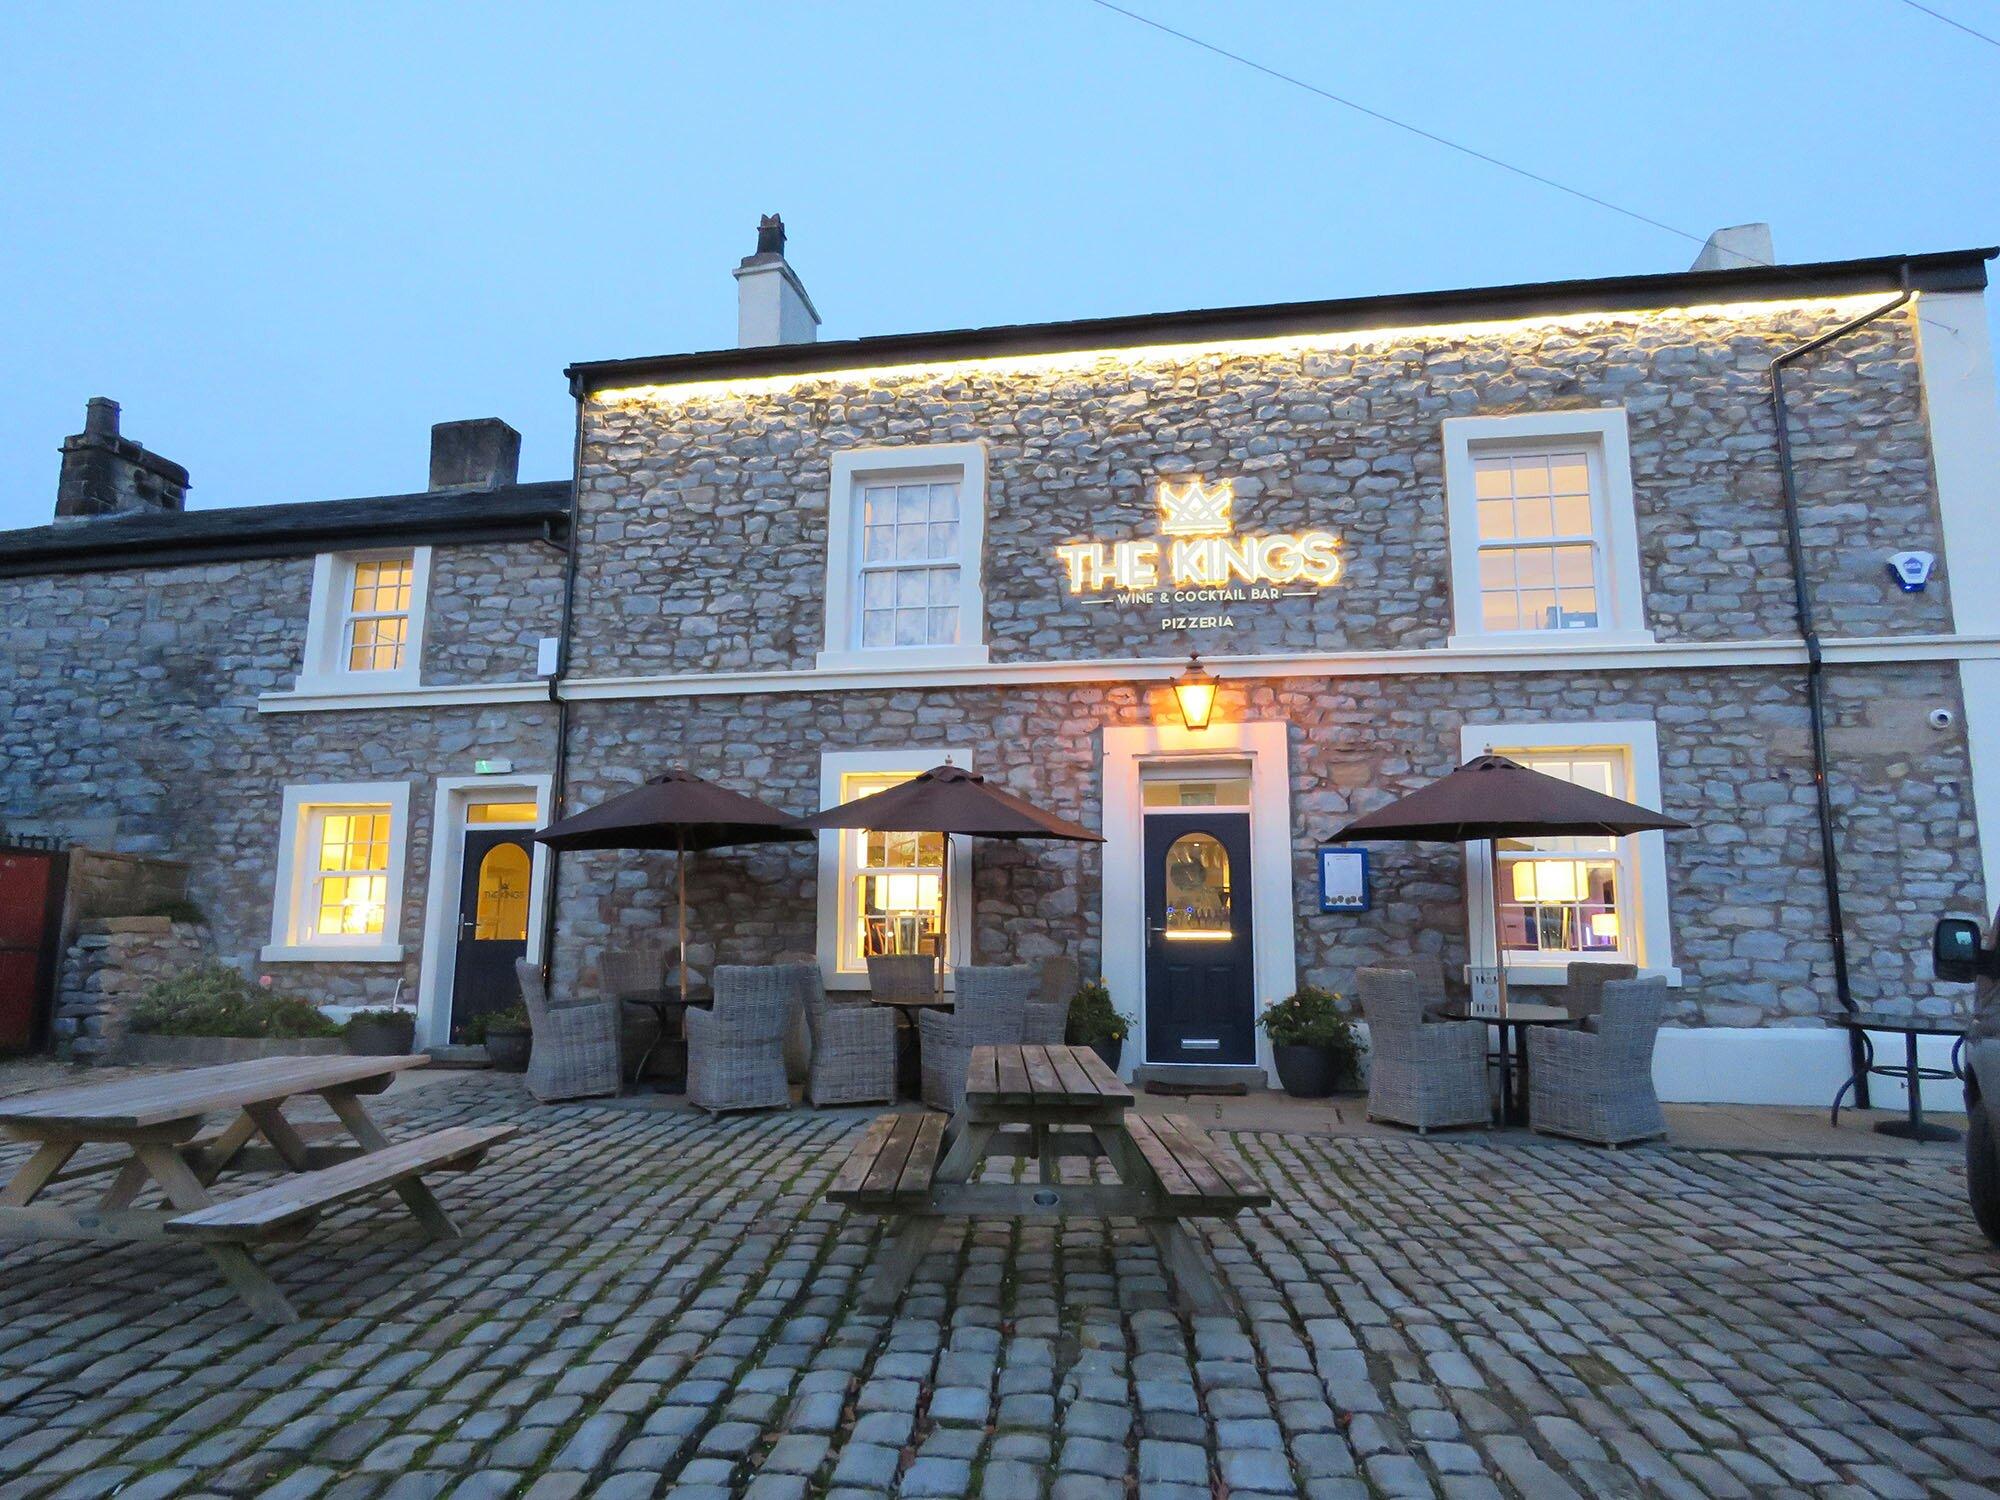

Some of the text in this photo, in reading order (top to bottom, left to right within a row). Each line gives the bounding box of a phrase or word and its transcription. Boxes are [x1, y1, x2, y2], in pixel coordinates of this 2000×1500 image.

[1058, 532, 1338, 590] THE KINGS
[1117, 588, 1279, 605] WINE & COCKTAIL BAR
[1161, 615, 1234, 630] PIZZERIA
